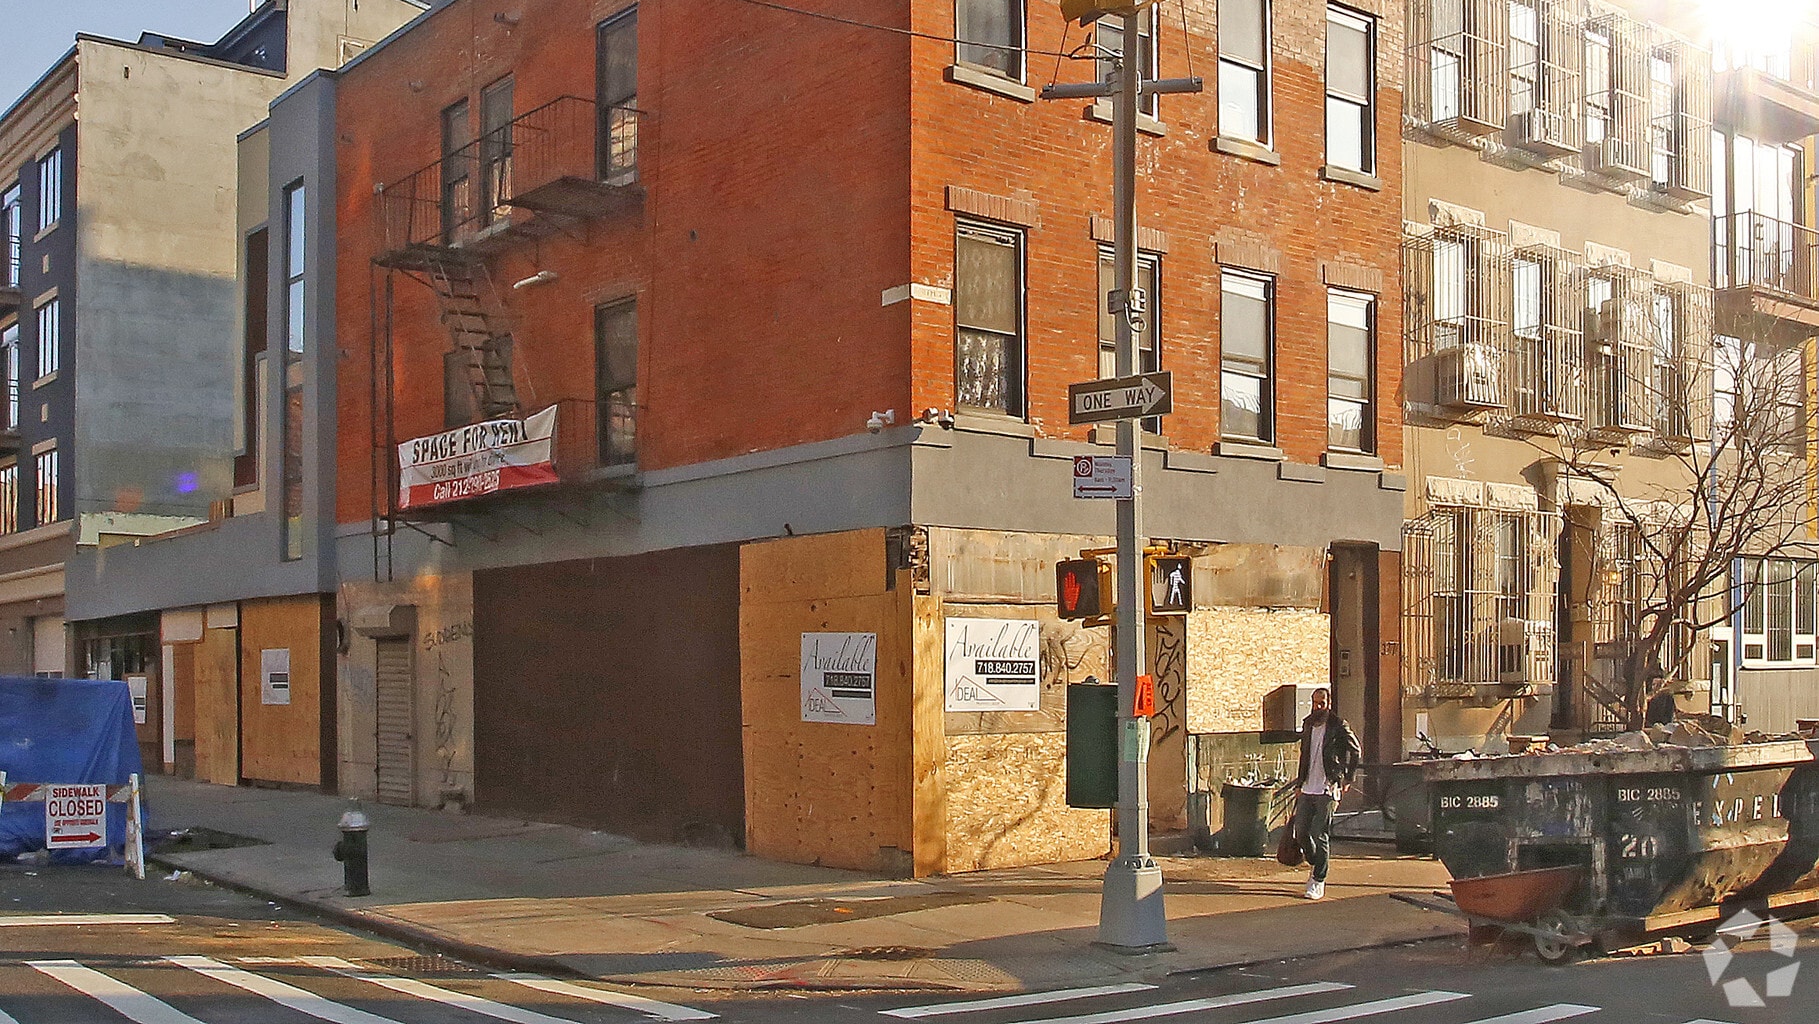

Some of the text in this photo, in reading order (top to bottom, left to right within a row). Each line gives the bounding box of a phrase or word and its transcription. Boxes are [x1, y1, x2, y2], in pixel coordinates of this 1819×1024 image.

[1083, 387, 1155, 410] ONE WAY
[412, 432, 457, 464] SPACE
[463, 426, 488, 453] FOR
[433, 481, 451, 500] Call
[948, 622, 1036, 661] Available
[803, 635, 875, 673] Available
[976, 661, 1034, 674] 718.840.2757
[52, 786, 100, 798] SIDEWALK
[1440, 795, 1499, 808] BIC 2885
[1617, 787, 1681, 802] BIC 2885
[48, 799, 104, 817] CLOSED
[1620, 833, 1658, 859] 20
